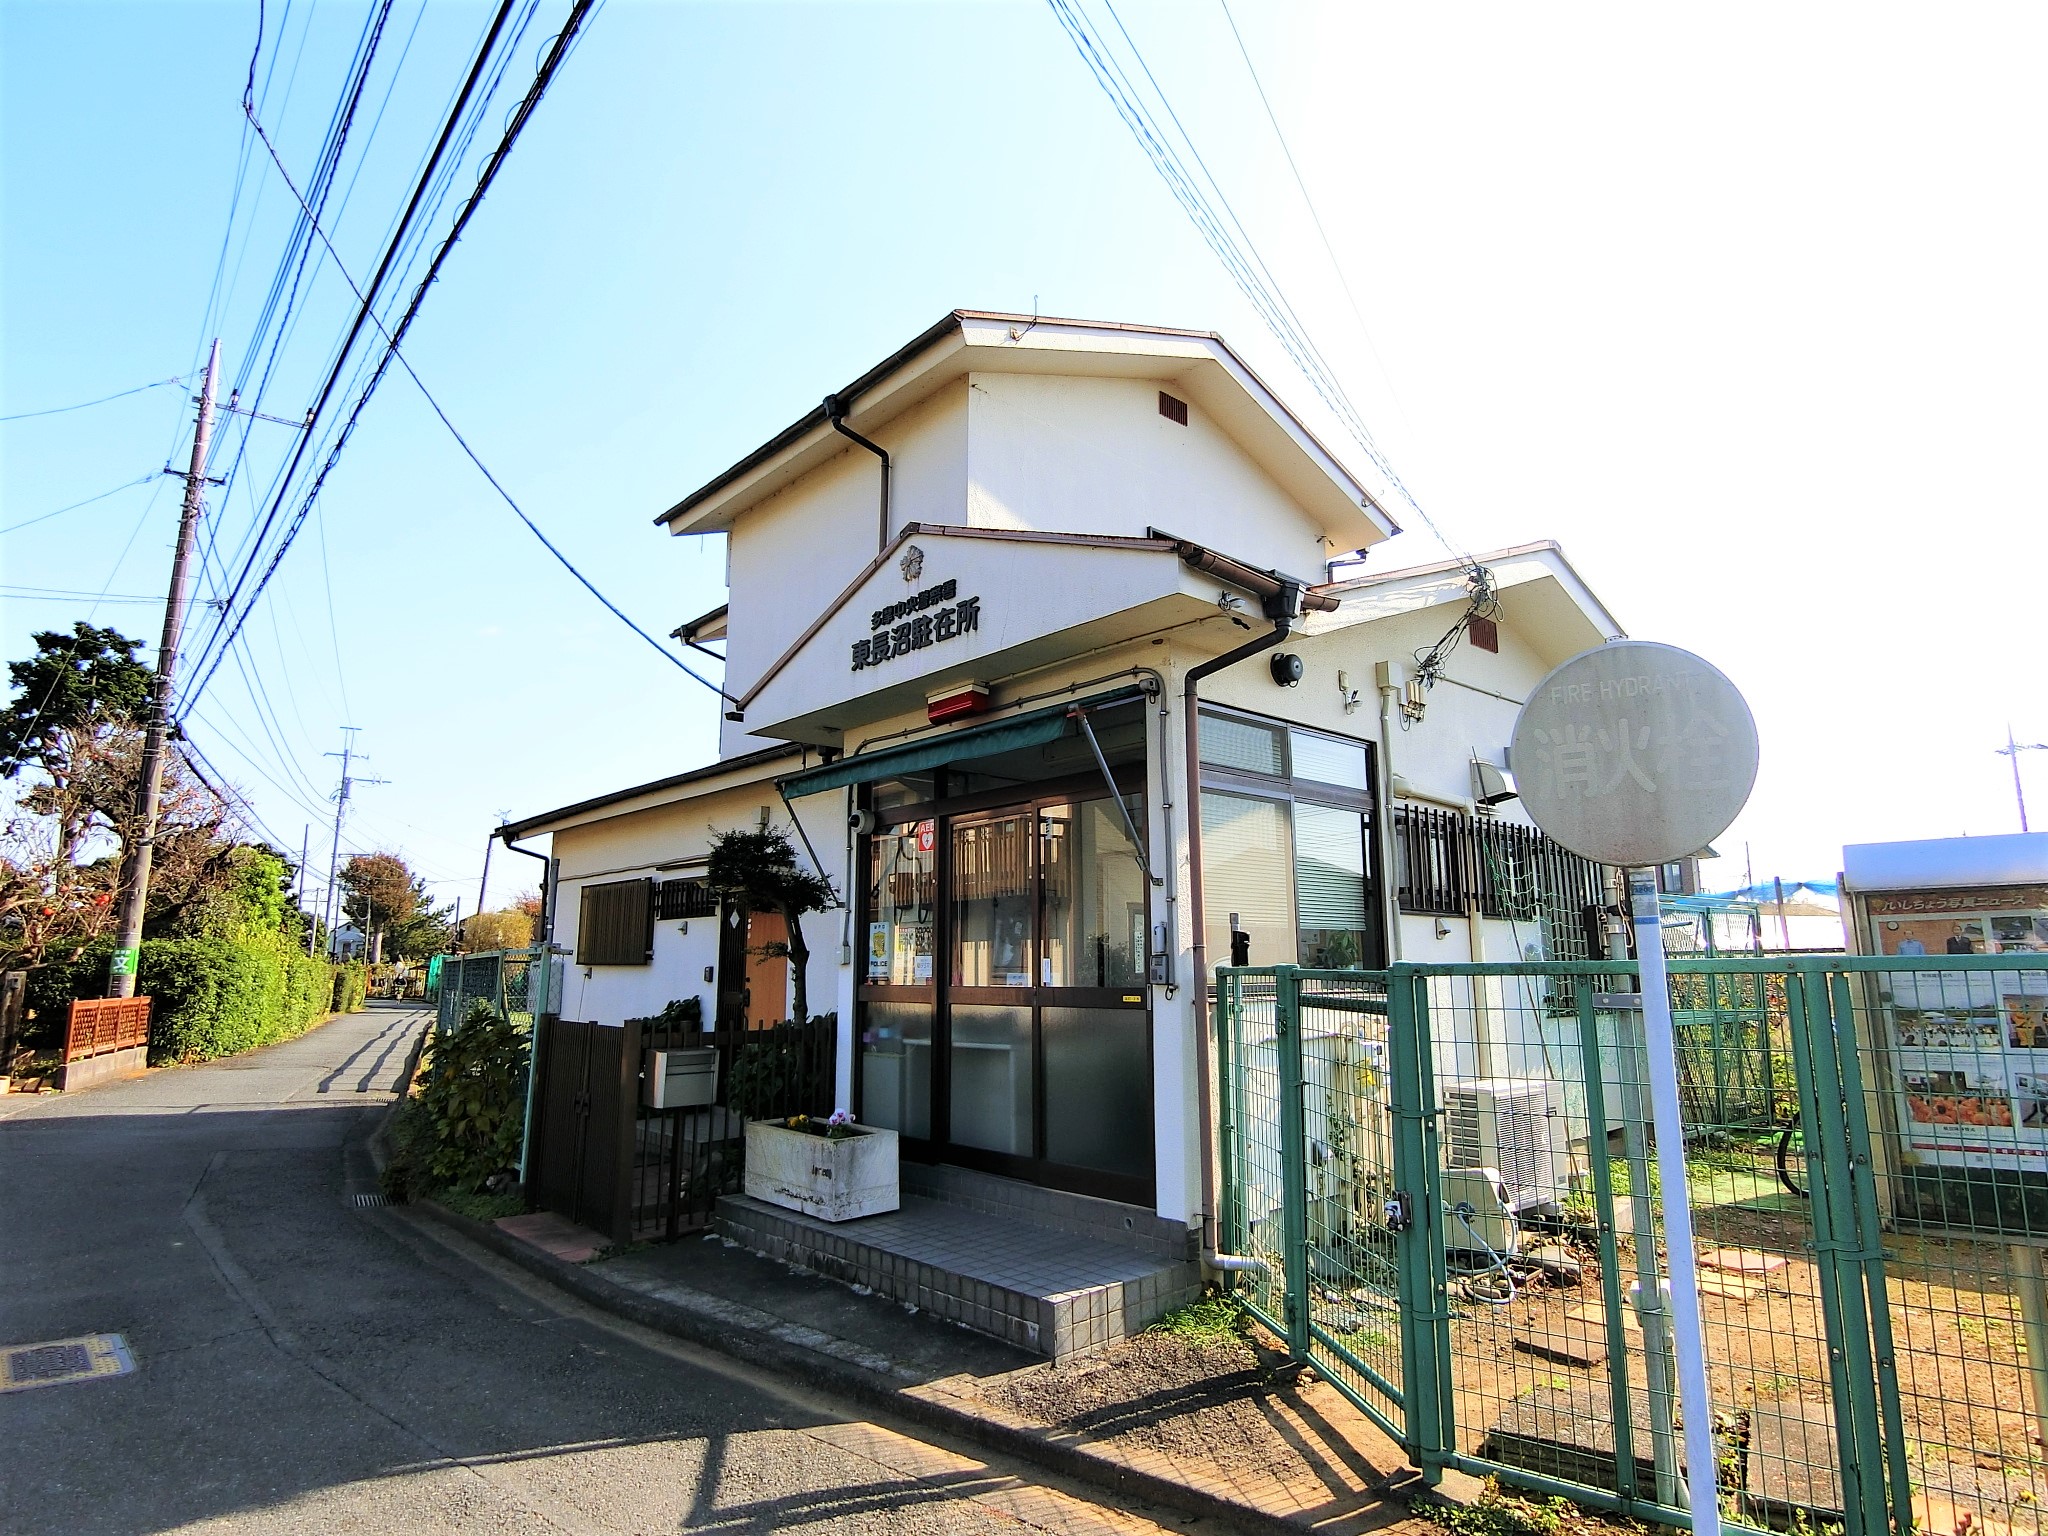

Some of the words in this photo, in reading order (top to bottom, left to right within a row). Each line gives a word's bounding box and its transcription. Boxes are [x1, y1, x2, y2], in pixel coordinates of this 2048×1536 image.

[871, 578, 957, 631] 多摩中央警察署
[851, 595, 981, 672] 東長沼駐在所
[1550, 682, 1592, 705] FIRE
[1600, 670, 1692, 700] HYDRANT
[1533, 708, 1730, 799] 消火栓
[920, 822, 935, 832] AED
